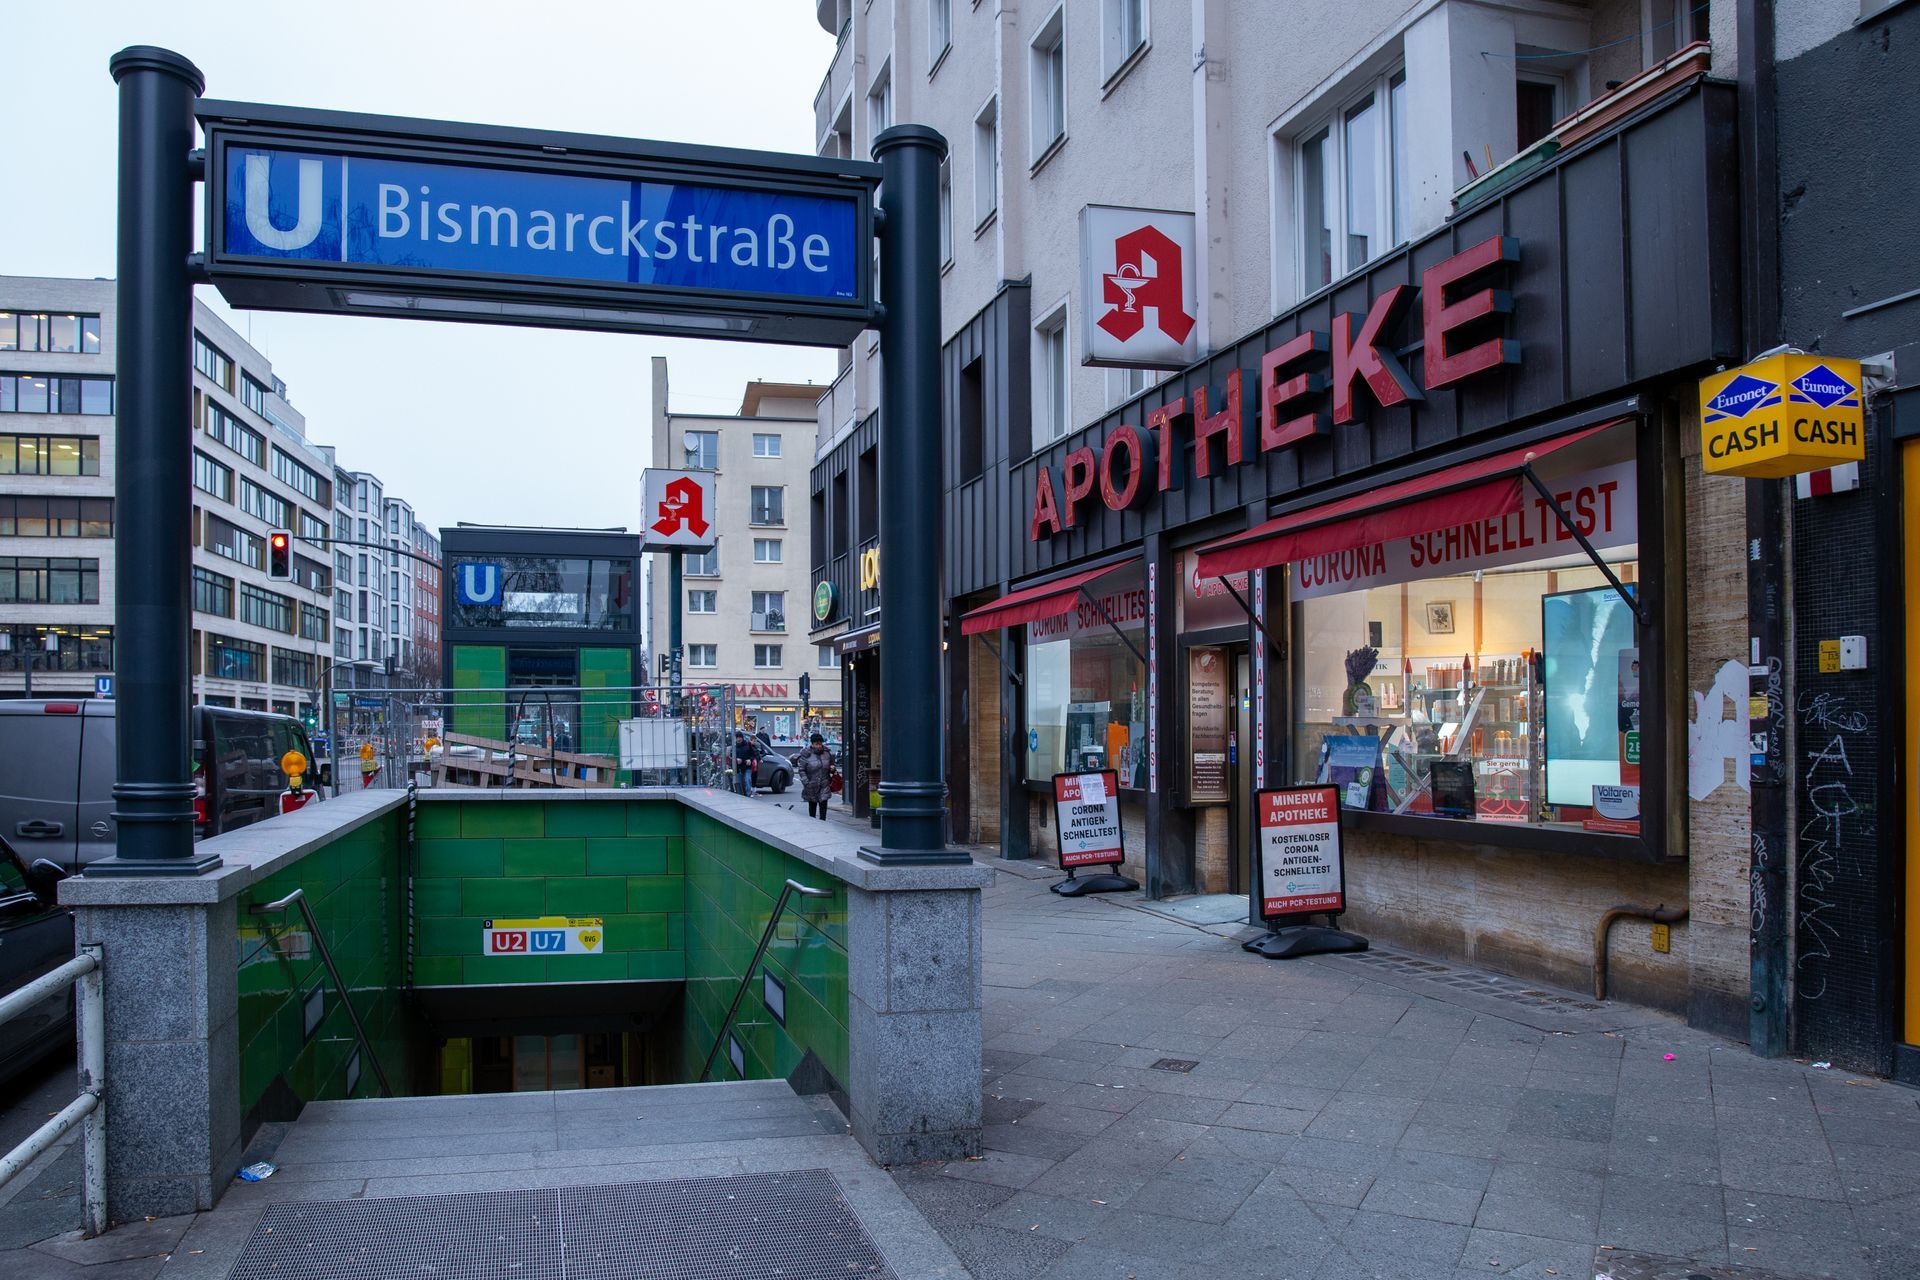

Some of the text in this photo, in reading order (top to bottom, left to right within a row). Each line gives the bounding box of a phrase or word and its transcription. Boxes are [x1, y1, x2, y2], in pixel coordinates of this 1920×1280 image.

[244, 155, 830, 274] U Bismarckstraße
[1031, 235, 1520, 542] APOTHEKE
[1800, 376, 1847, 396] Euronet
[1716, 385, 1768, 410] Euronet
[1793, 418, 1857, 446] CASH
[1708, 420, 1780, 459] CASH
[1300, 481, 1619, 589] CORONA SCHNELLTEST
[464, 565, 495, 603] U
[1033, 613, 1069, 638] CORONA
[98, 678, 111, 693] U
[1598, 785, 1634, 798] Voltaren
[1272, 792, 1324, 806] MINERVA
[1071, 804, 1105, 815] CORONA
[1269, 808, 1329, 822] APOTHEKE
[1071, 815, 1108, 828] ANTIGEN-
[1063, 826, 1118, 841] SCHNELLTEST
[1271, 833, 1330, 845] KOSTENLOSER
[1065, 850, 1118, 862] AUCH PCR-TESTUNG
[1284, 844, 1320, 855] CORONA
[1282, 854, 1322, 866] ANTIGEN-
[1274, 865, 1331, 877] SCHNELLTEST
[1267, 896, 1337, 909] AUCH PCR-TESTUNG
[485, 920, 492, 928] D
[496, 933, 562, 950] U2 U7
